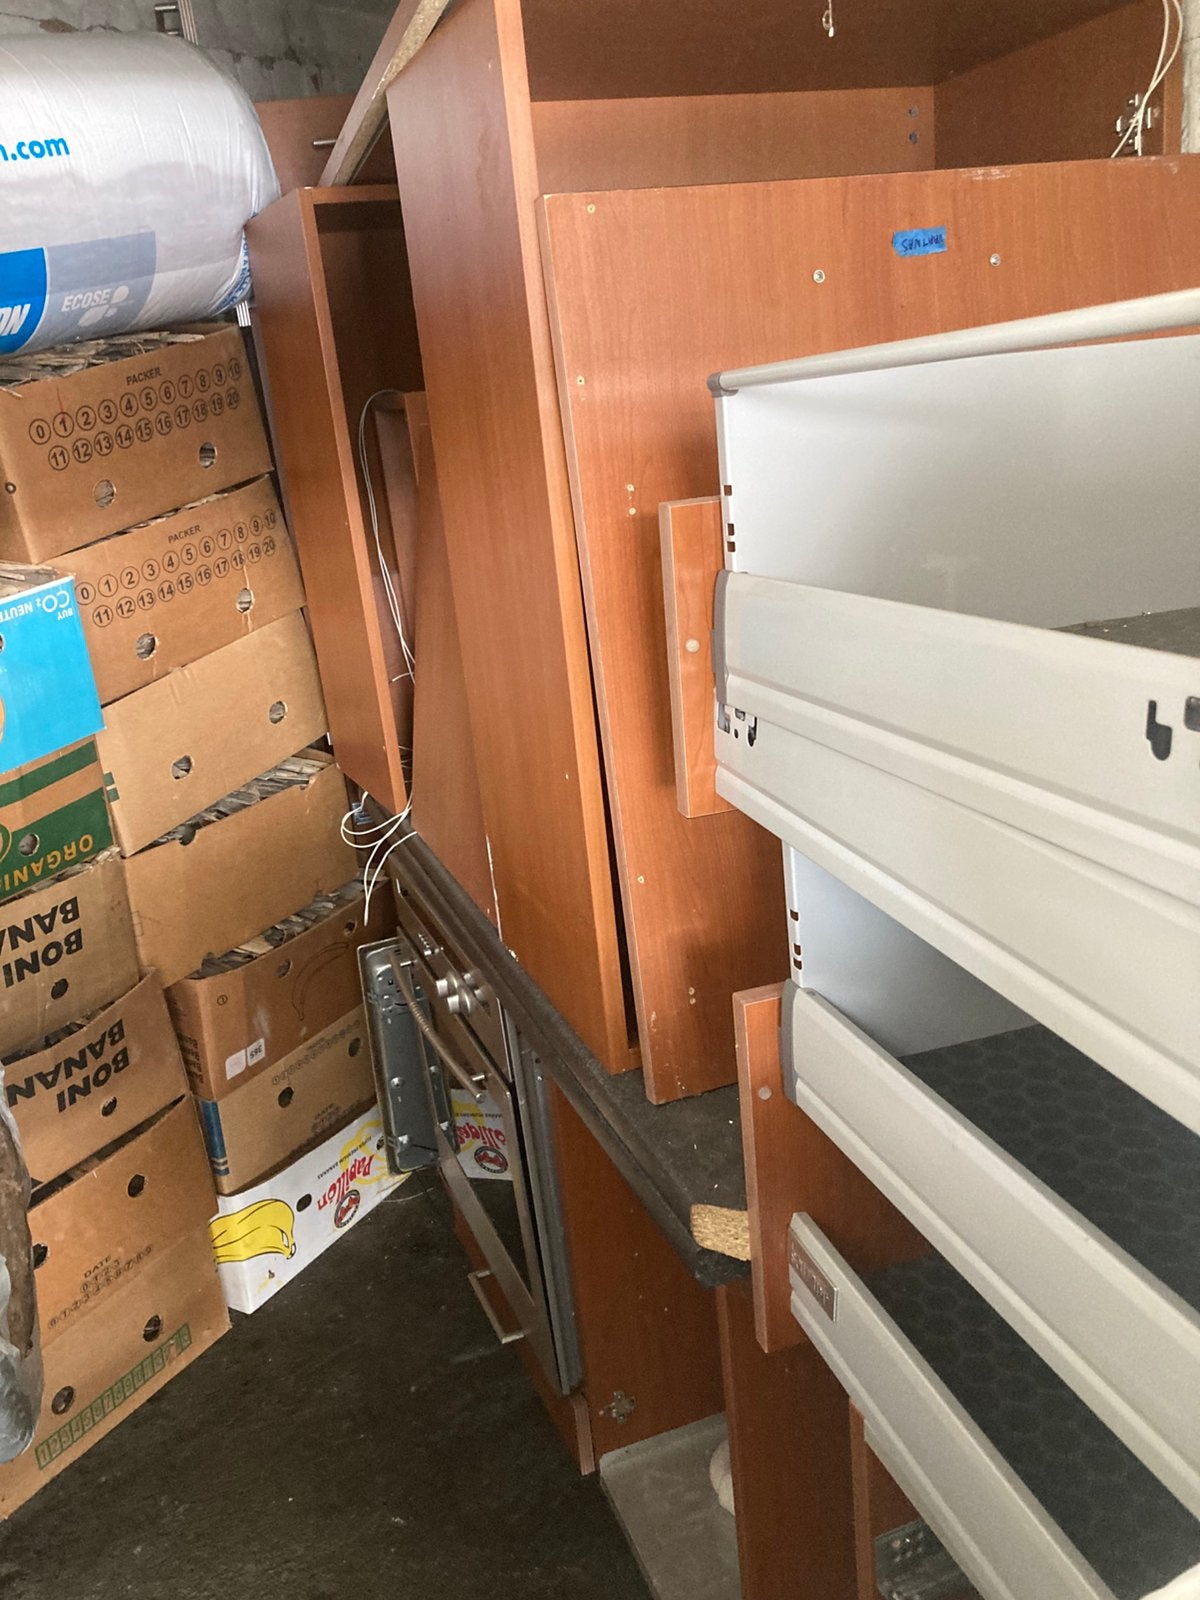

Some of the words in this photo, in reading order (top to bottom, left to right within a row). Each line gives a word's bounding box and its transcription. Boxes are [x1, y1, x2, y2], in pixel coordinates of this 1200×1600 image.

[61, 288, 111, 312] ECOSE
[126, 366, 162, 386] PACKER
[51, 449, 67, 466] 11
[74, 443, 91, 459] 12
[96, 436, 112, 452] 13
[117, 429, 132, 445] 14
[137, 422, 152, 438] 15
[158, 416, 172, 431] 16
[177, 409, 190, 424] 17
[195, 404, 208, 418] 18
[168, 524, 201, 544] PACKER
[265, 512, 275, 526] 10
[95, 609, 110, 624] 11
[117, 600, 133, 616] 12
[139, 592, 154, 607] 13
[160, 584, 174, 599] 14
[180, 576, 192, 591] 15
[197, 567, 211, 582] 16
[216, 560, 228, 574] 17
[249, 546, 261, 560] 19
[263, 539, 276, 553] 20
[57, 608, 73, 621] BUY
[0, 834, 93, 891] ORGANI
[3, 928, 83, 988] BONI
[6, 1019, 125, 1108] BANAN
[56, 1046, 130, 1113] BONI
[84, 1255, 111, 1278] DATE
